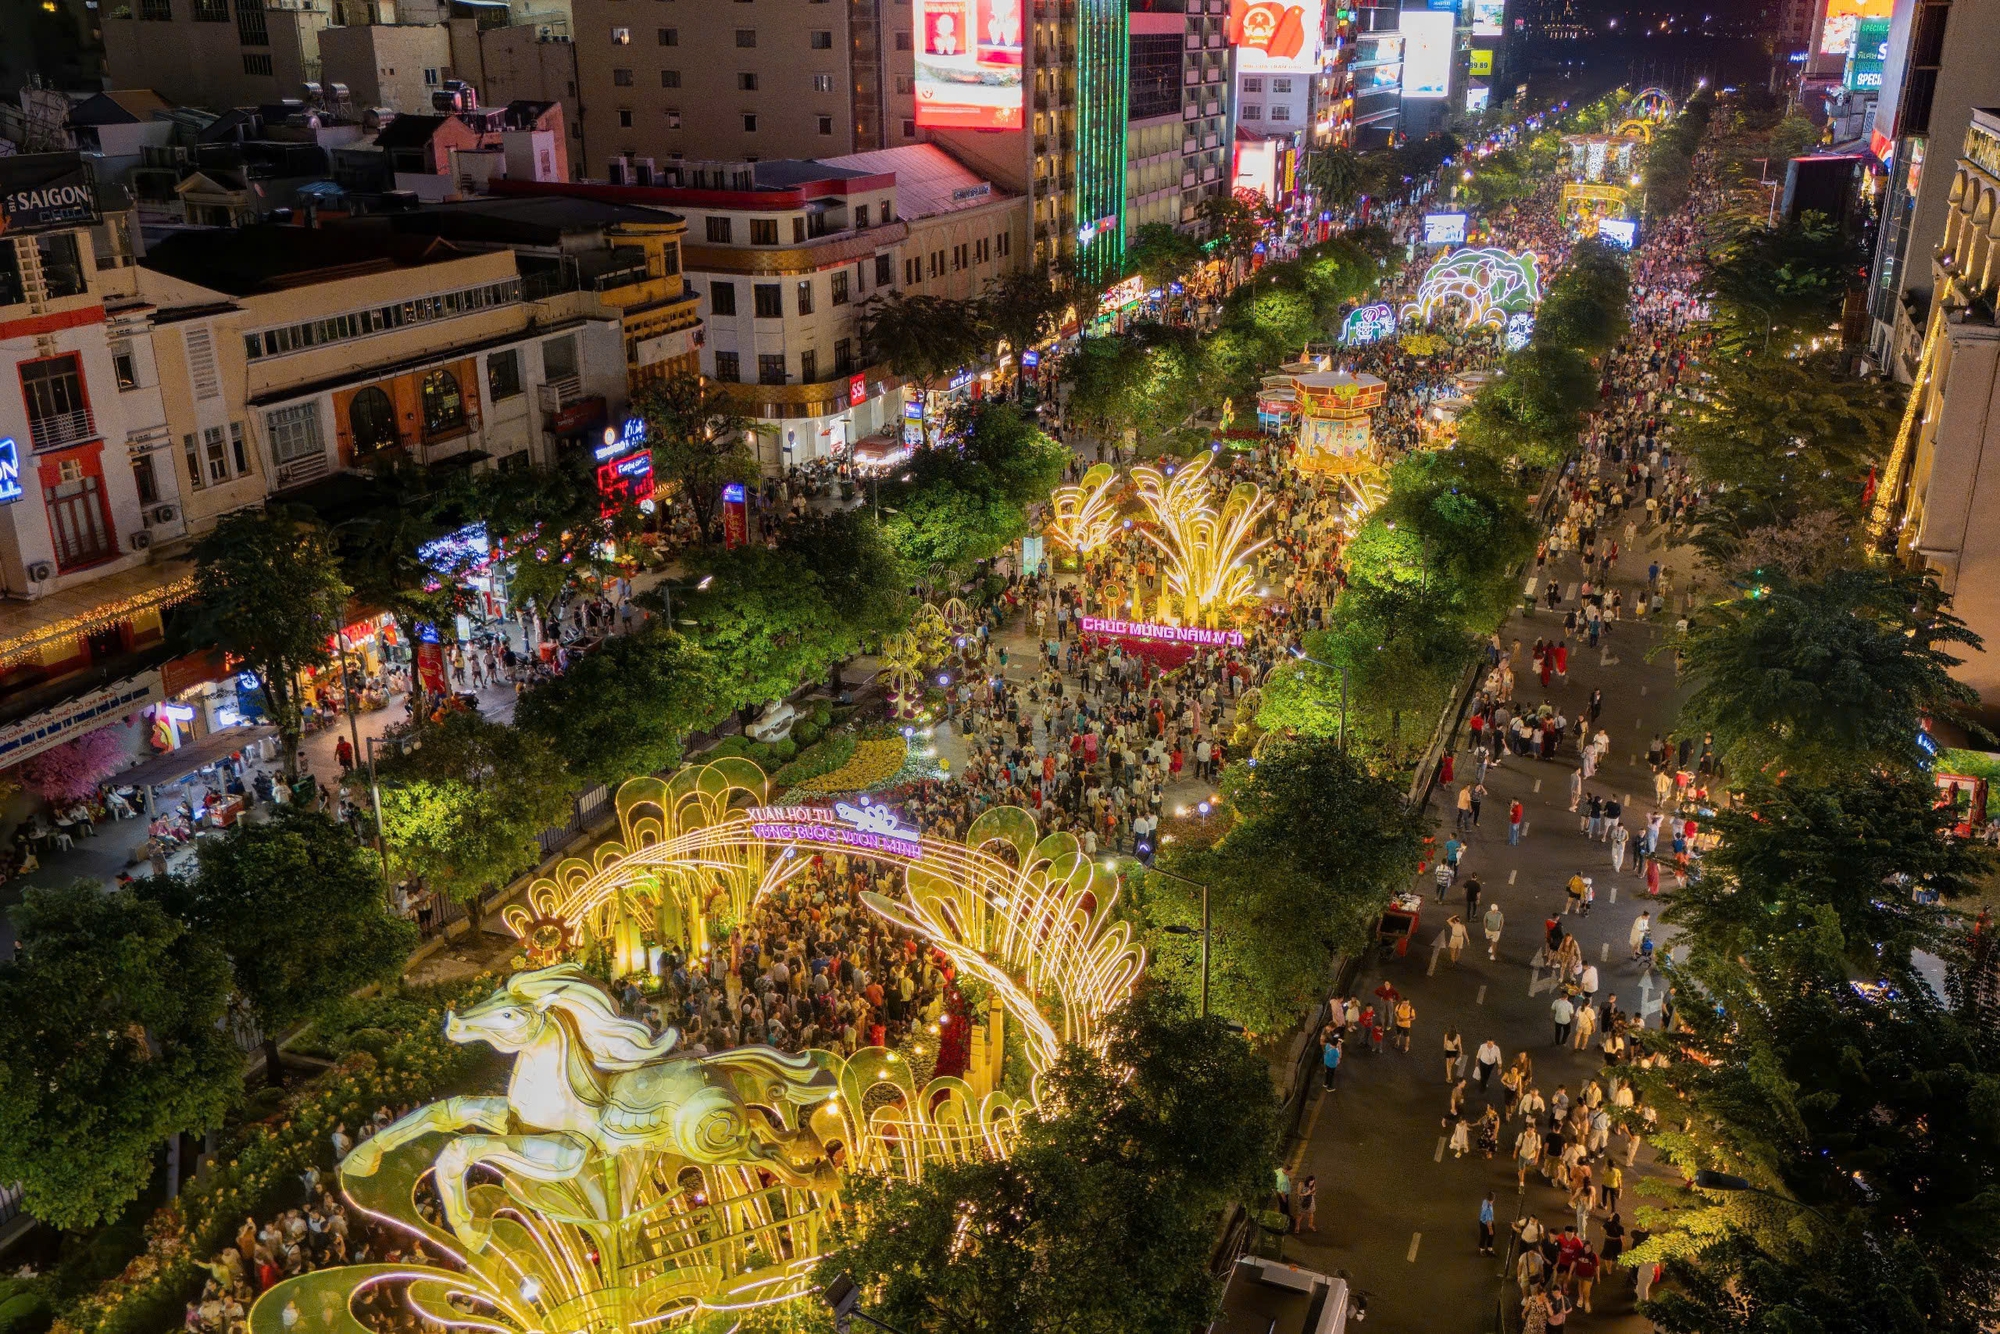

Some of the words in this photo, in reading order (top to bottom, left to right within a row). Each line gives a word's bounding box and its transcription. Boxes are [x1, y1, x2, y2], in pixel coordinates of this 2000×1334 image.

[7, 193, 17, 213] BIA
[17, 184, 89, 210] SAIGON
[851, 380, 865, 399] SSI
[1082, 615, 1128, 634] CHÚC
[1176, 625, 1211, 643] NĂM
